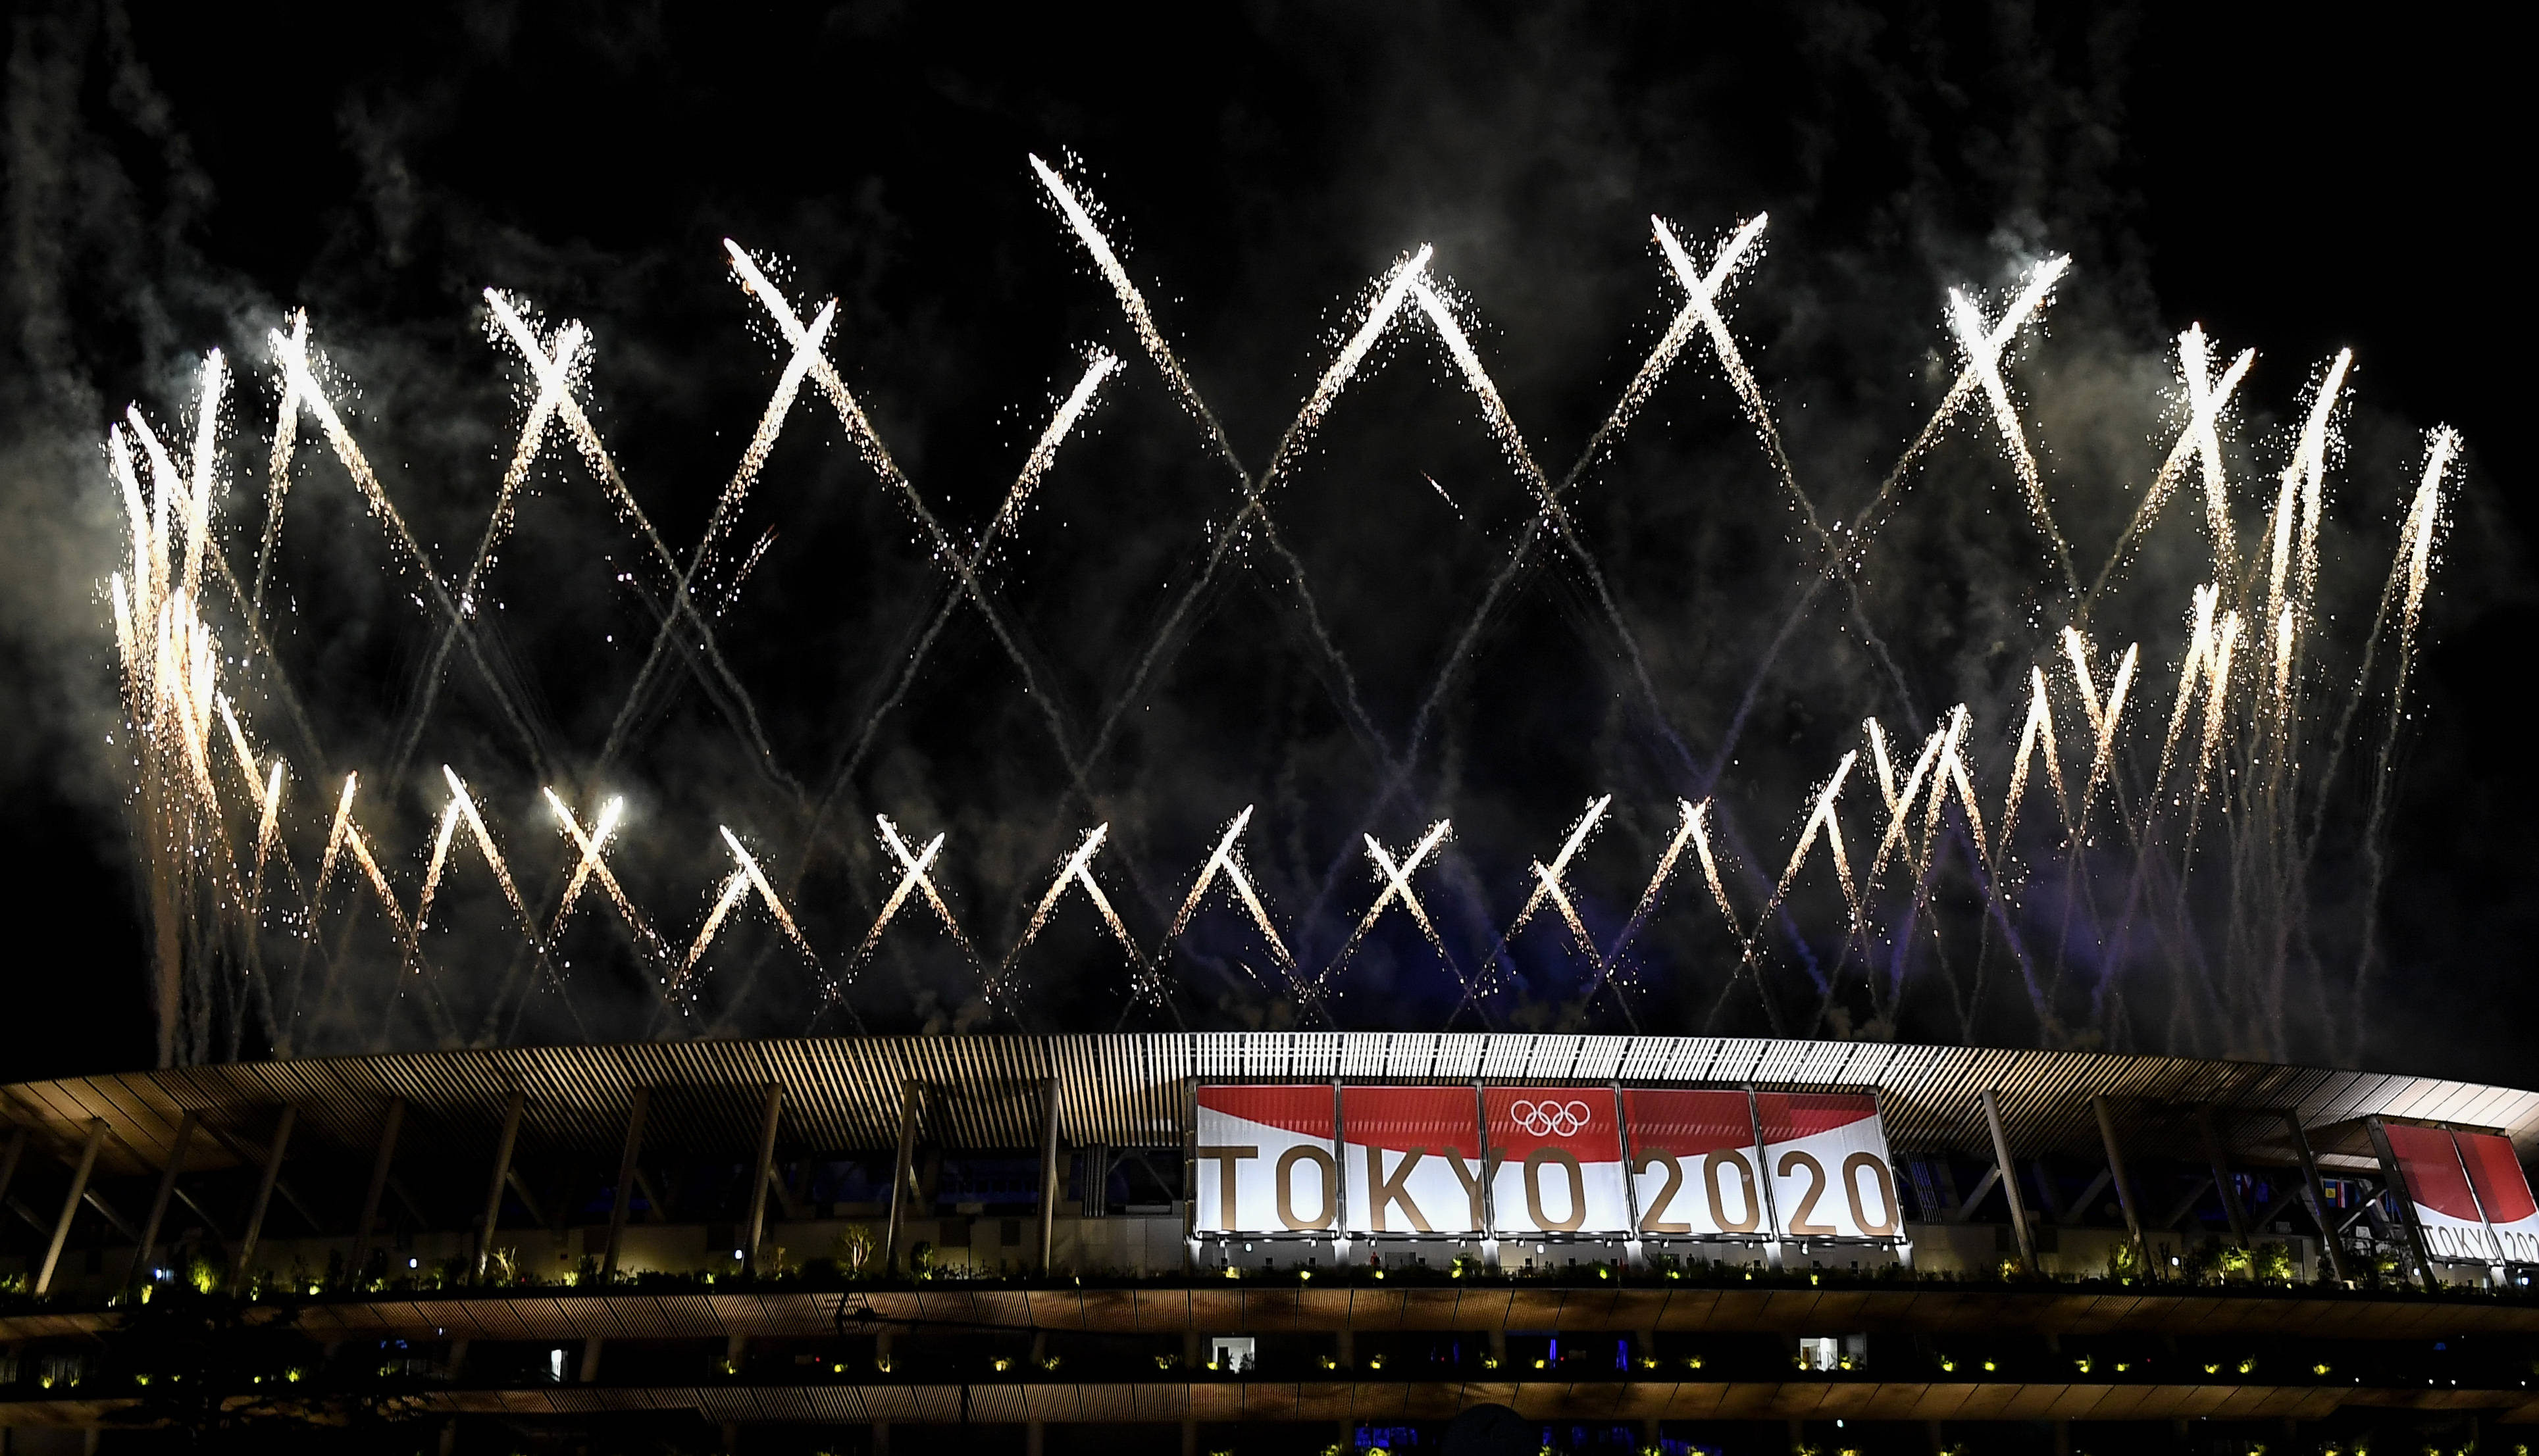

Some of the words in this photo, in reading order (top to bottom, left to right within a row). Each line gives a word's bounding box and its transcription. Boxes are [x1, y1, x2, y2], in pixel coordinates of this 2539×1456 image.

[1198, 1145, 1586, 1232] TOKYO
[1632, 1149, 1900, 1236] 2020
[2423, 1224, 2505, 1260] TOKYO
